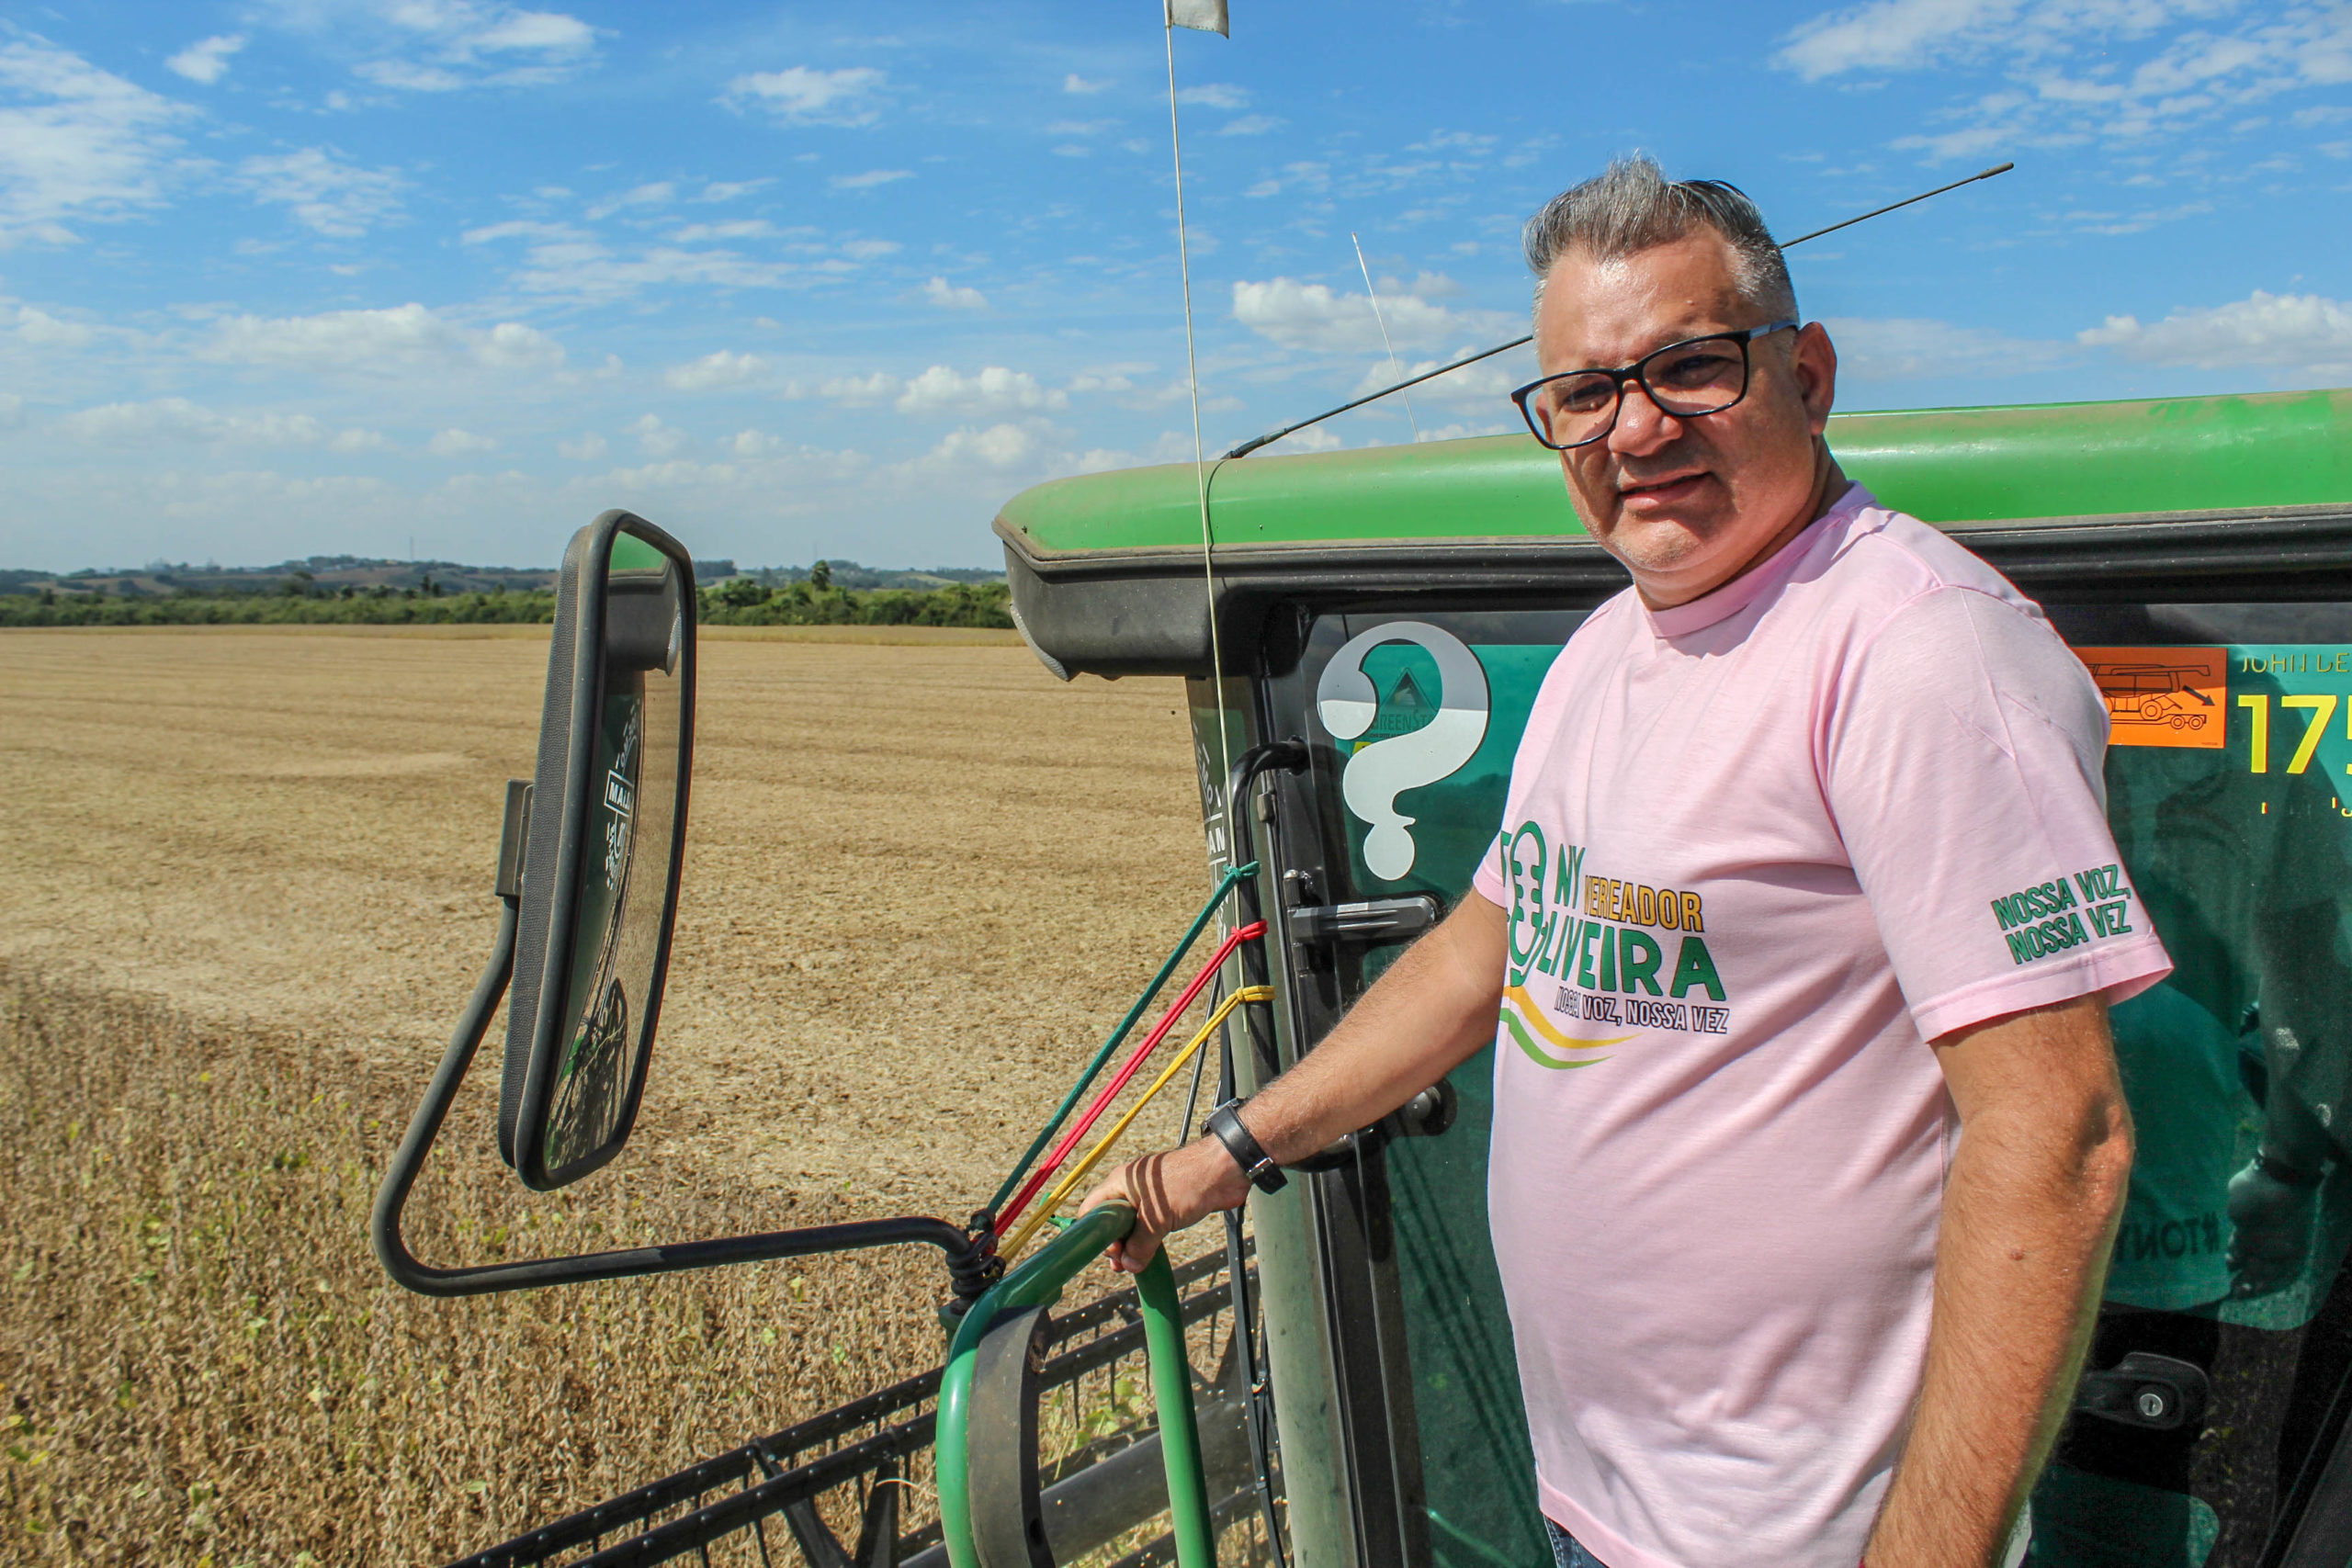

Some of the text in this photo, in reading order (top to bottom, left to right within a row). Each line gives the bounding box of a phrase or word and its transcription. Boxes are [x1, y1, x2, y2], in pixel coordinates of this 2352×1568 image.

[1585, 874, 1705, 932] VEREADOR
[1991, 863, 2132, 931] NOSSA VOZ,
[2005, 899, 2132, 964] NOSSA VEZ
[1582, 995, 1623, 1026] VOZ,
[1626, 999, 1687, 1031] NOSSA
[1691, 1006, 1729, 1034] VEZ
